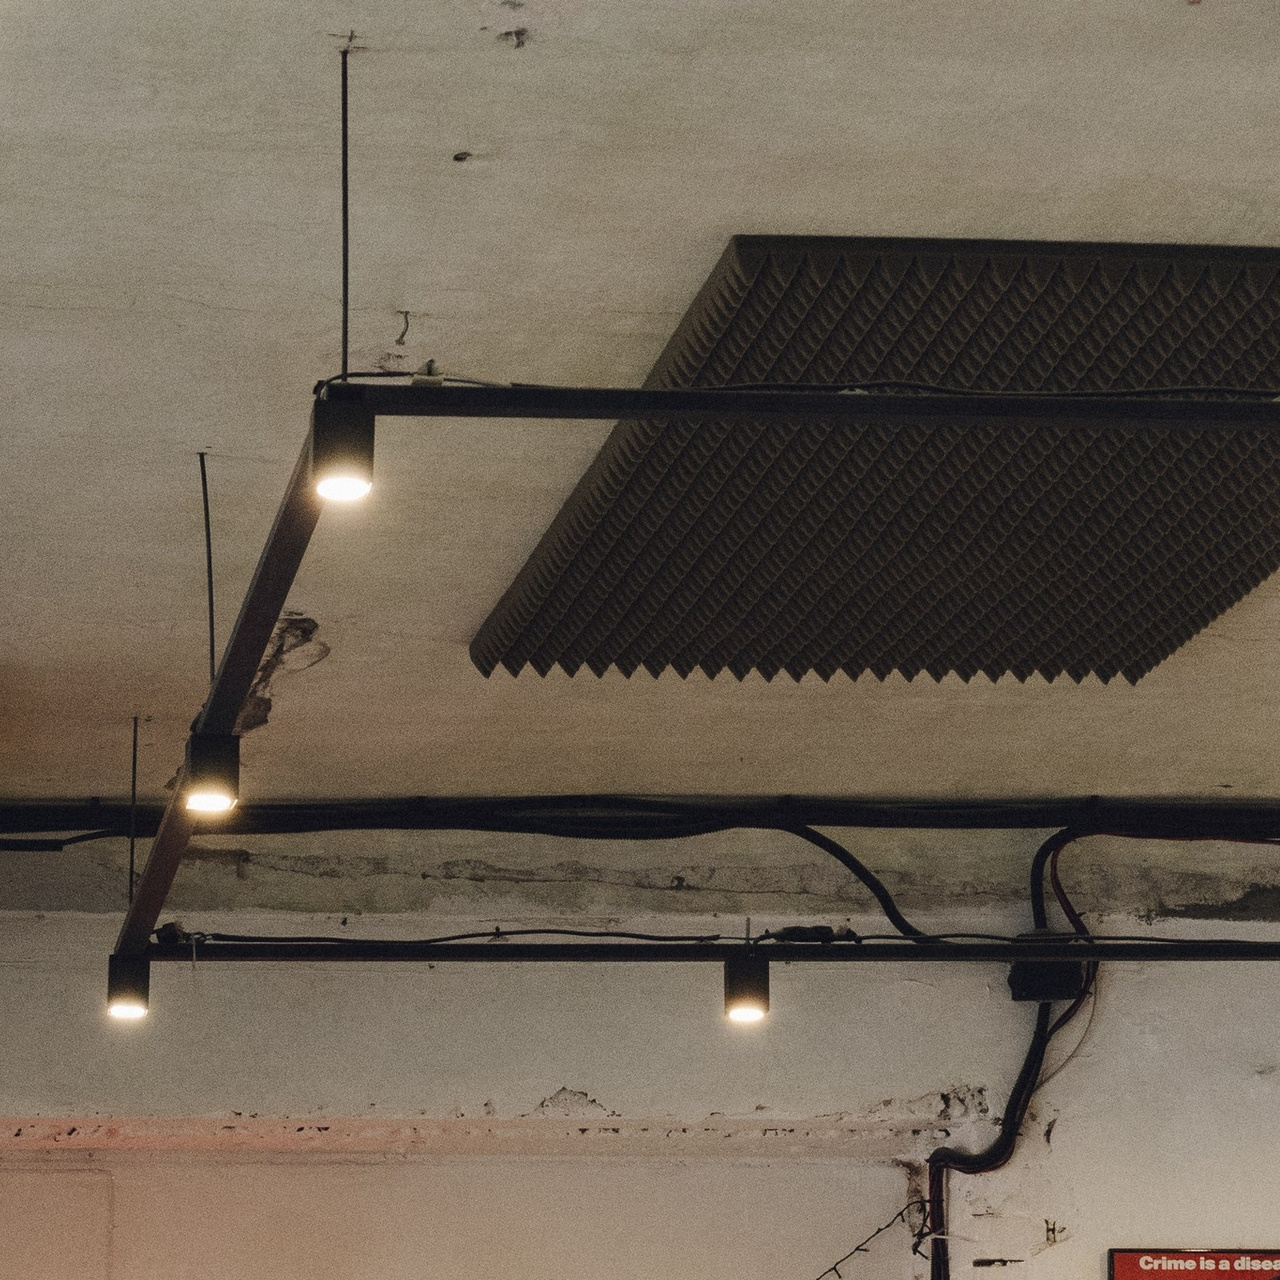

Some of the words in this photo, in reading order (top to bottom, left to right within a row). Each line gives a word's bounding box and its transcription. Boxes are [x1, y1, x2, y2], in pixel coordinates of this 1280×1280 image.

[1139, 1255, 1197, 1271] Crime
[1199, 1256, 1216, 1271] is
[1218, 1259, 1231, 1271] a
[1234, 1256, 1280, 1271] disea
